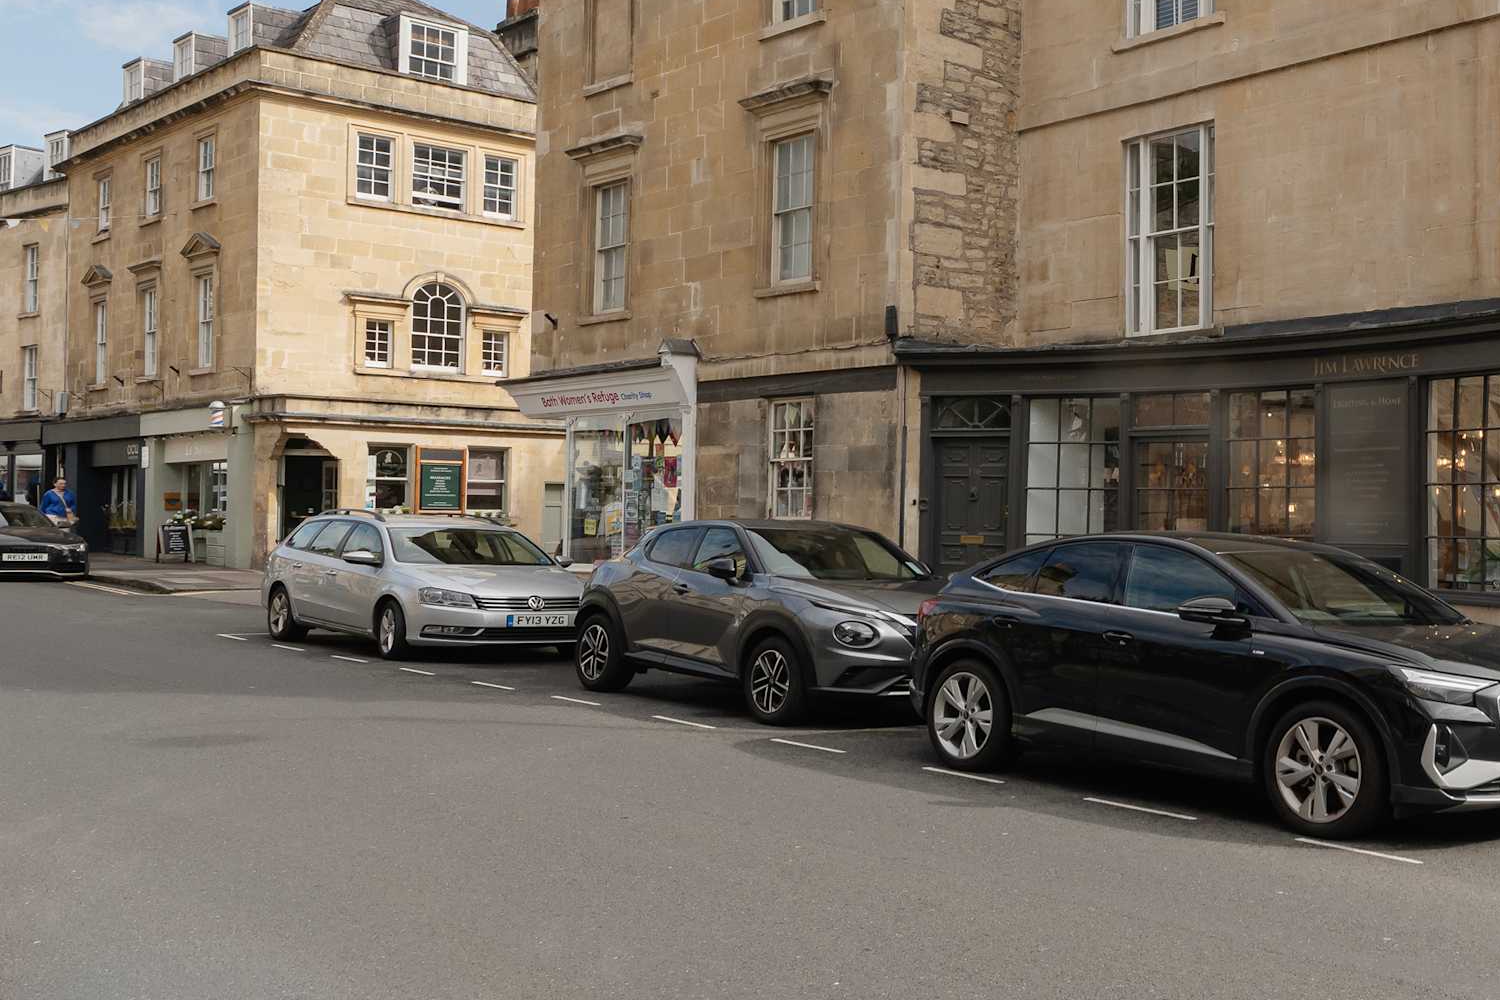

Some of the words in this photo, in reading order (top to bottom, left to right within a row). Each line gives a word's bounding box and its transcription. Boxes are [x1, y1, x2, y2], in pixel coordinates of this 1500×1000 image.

[1313, 357, 1338, 377] JIM
[541, 395, 559, 408] Bath
[559, 393, 591, 406] Women's
[592, 390, 620, 404] Refuge
[517, 616, 541, 625] FY13
[545, 616, 565, 625] YZG
